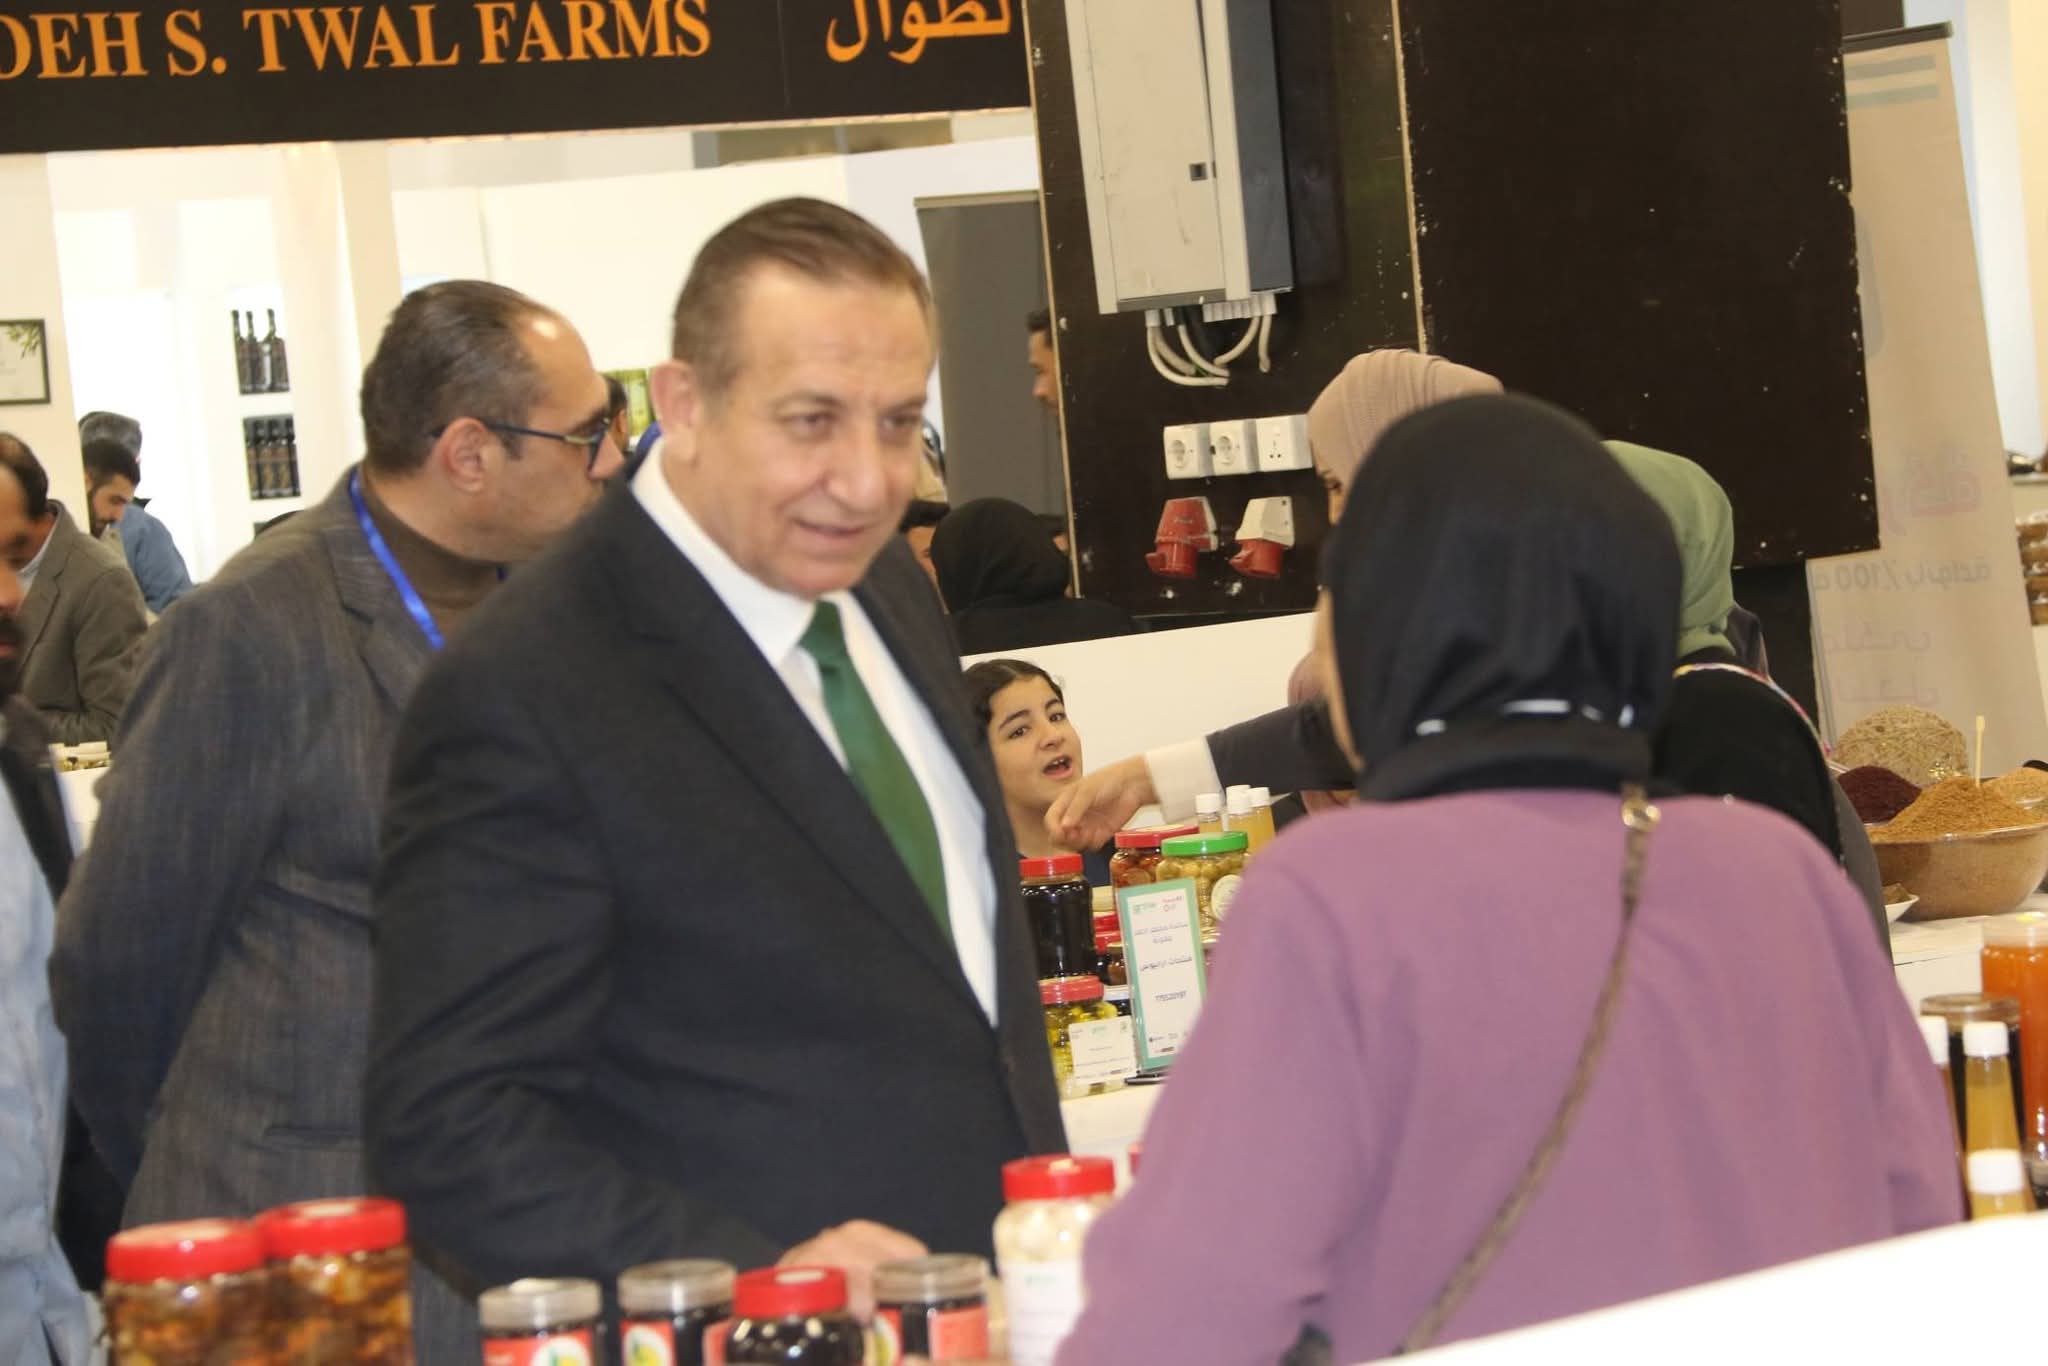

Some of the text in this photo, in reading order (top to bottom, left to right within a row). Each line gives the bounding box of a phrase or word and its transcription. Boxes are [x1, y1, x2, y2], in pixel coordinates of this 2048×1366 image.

[165, 10, 227, 75] S.
[242, 4, 459, 72] TWAL
[474, 0, 711, 64] FARMS
